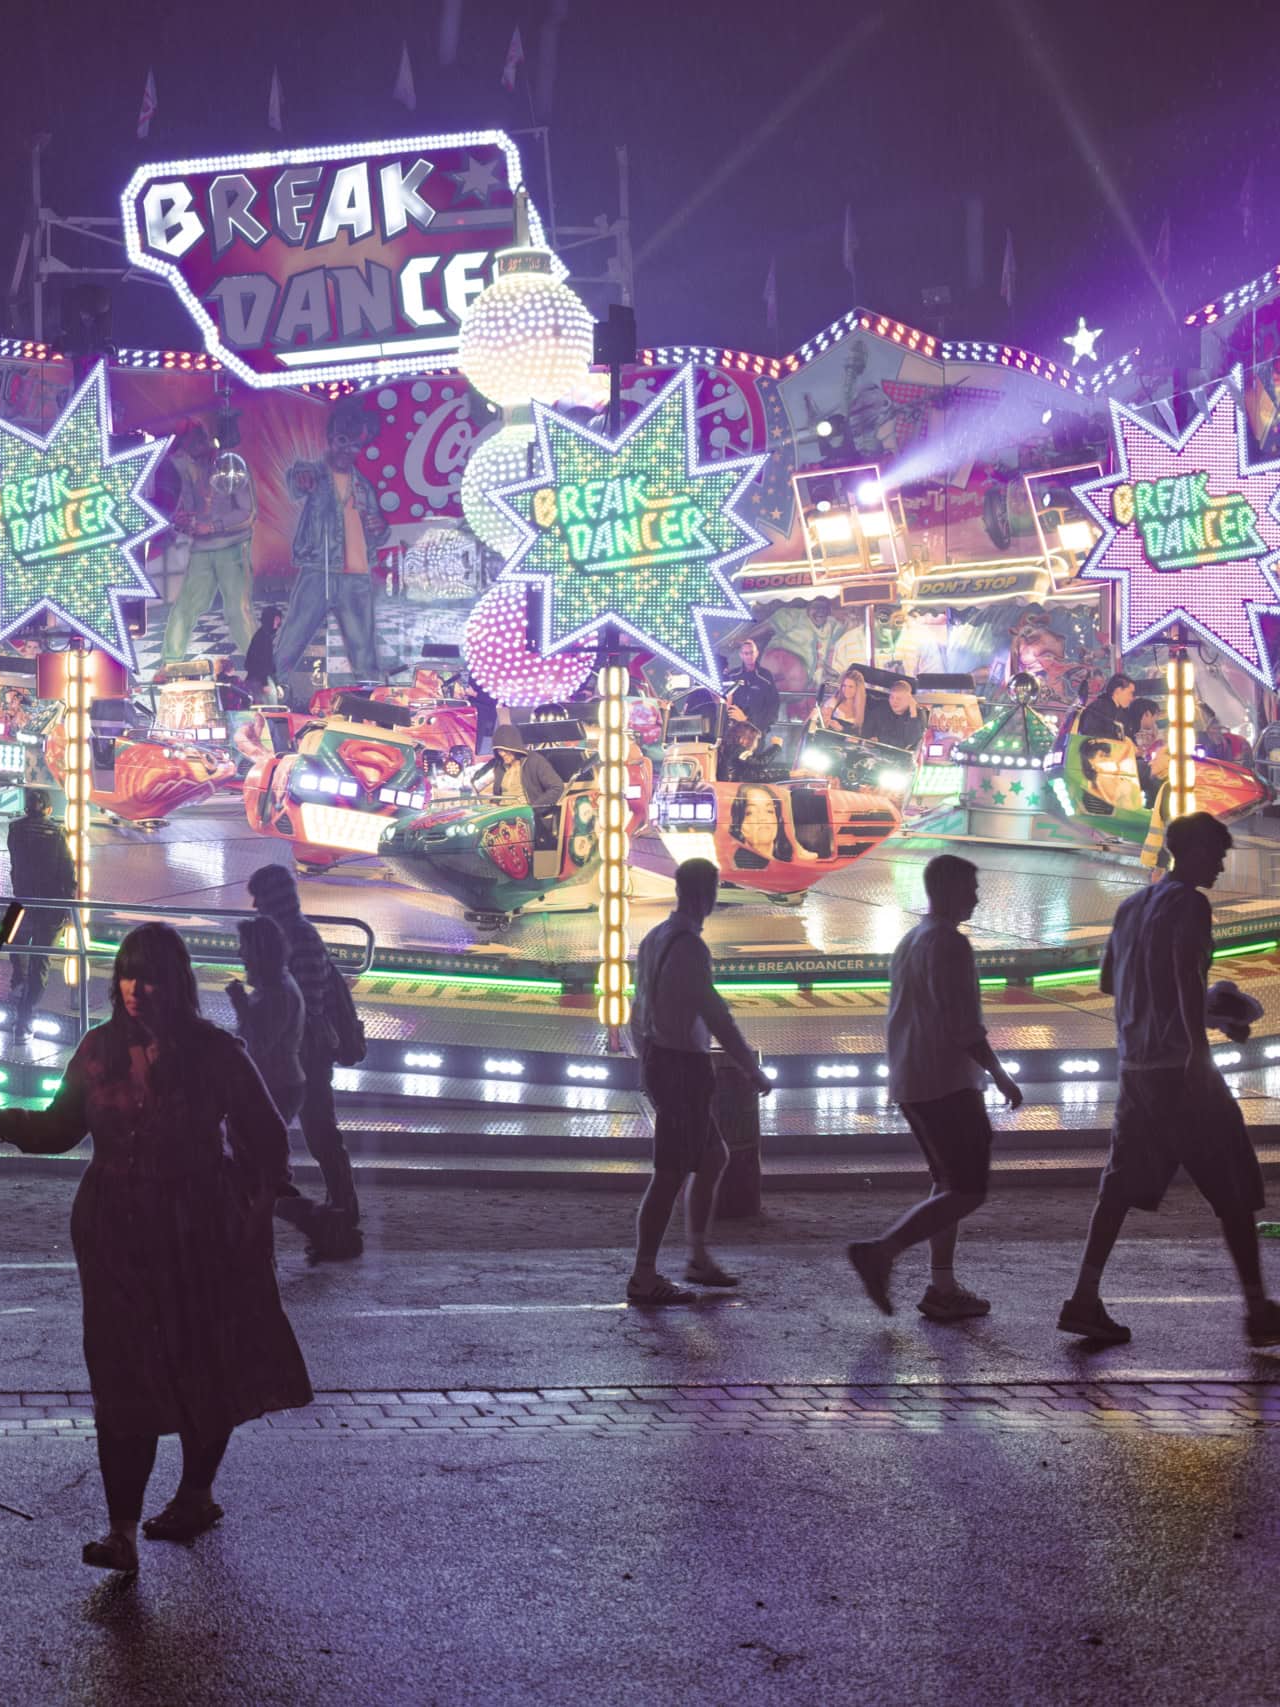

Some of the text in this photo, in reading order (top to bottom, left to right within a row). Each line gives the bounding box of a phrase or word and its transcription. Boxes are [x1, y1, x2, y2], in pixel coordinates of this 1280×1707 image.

[143, 158, 436, 257] BREAK
[212, 250, 504, 347] DANCE
[10, 495, 119, 551] DANCER
[534, 475, 647, 528] BREAK
[1113, 472, 1210, 525] BREAK
[568, 507, 710, 560] DANCER
[1143, 506, 1260, 557] DANCER
[973, 576, 1017, 591] STOP
[757, 959, 864, 972] BREAKDANCER
